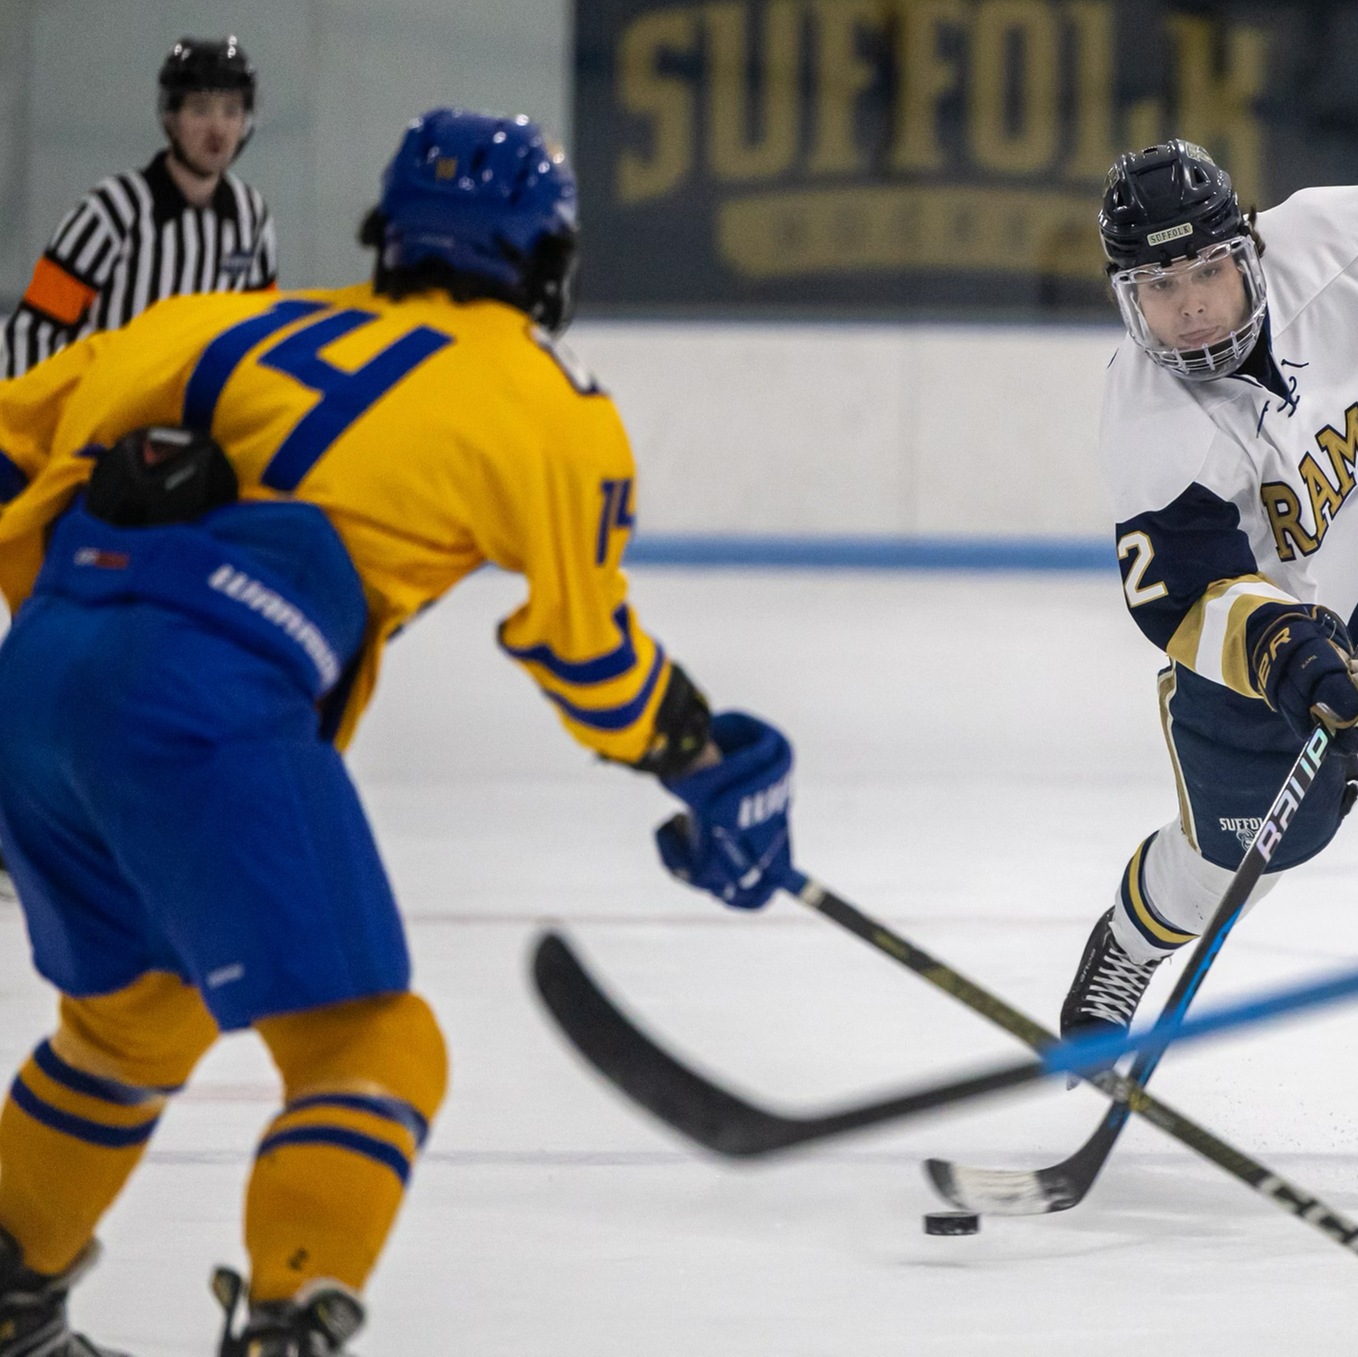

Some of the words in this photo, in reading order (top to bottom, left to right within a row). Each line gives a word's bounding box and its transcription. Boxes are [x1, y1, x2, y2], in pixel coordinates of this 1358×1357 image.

[614, 0, 1274, 208] SUFFOLK
[1150, 225, 1190, 243] SUFFOLK
[183, 300, 456, 496] 14
[1118, 530, 1169, 608] 2
[1219, 817, 1263, 831] SUFFO
